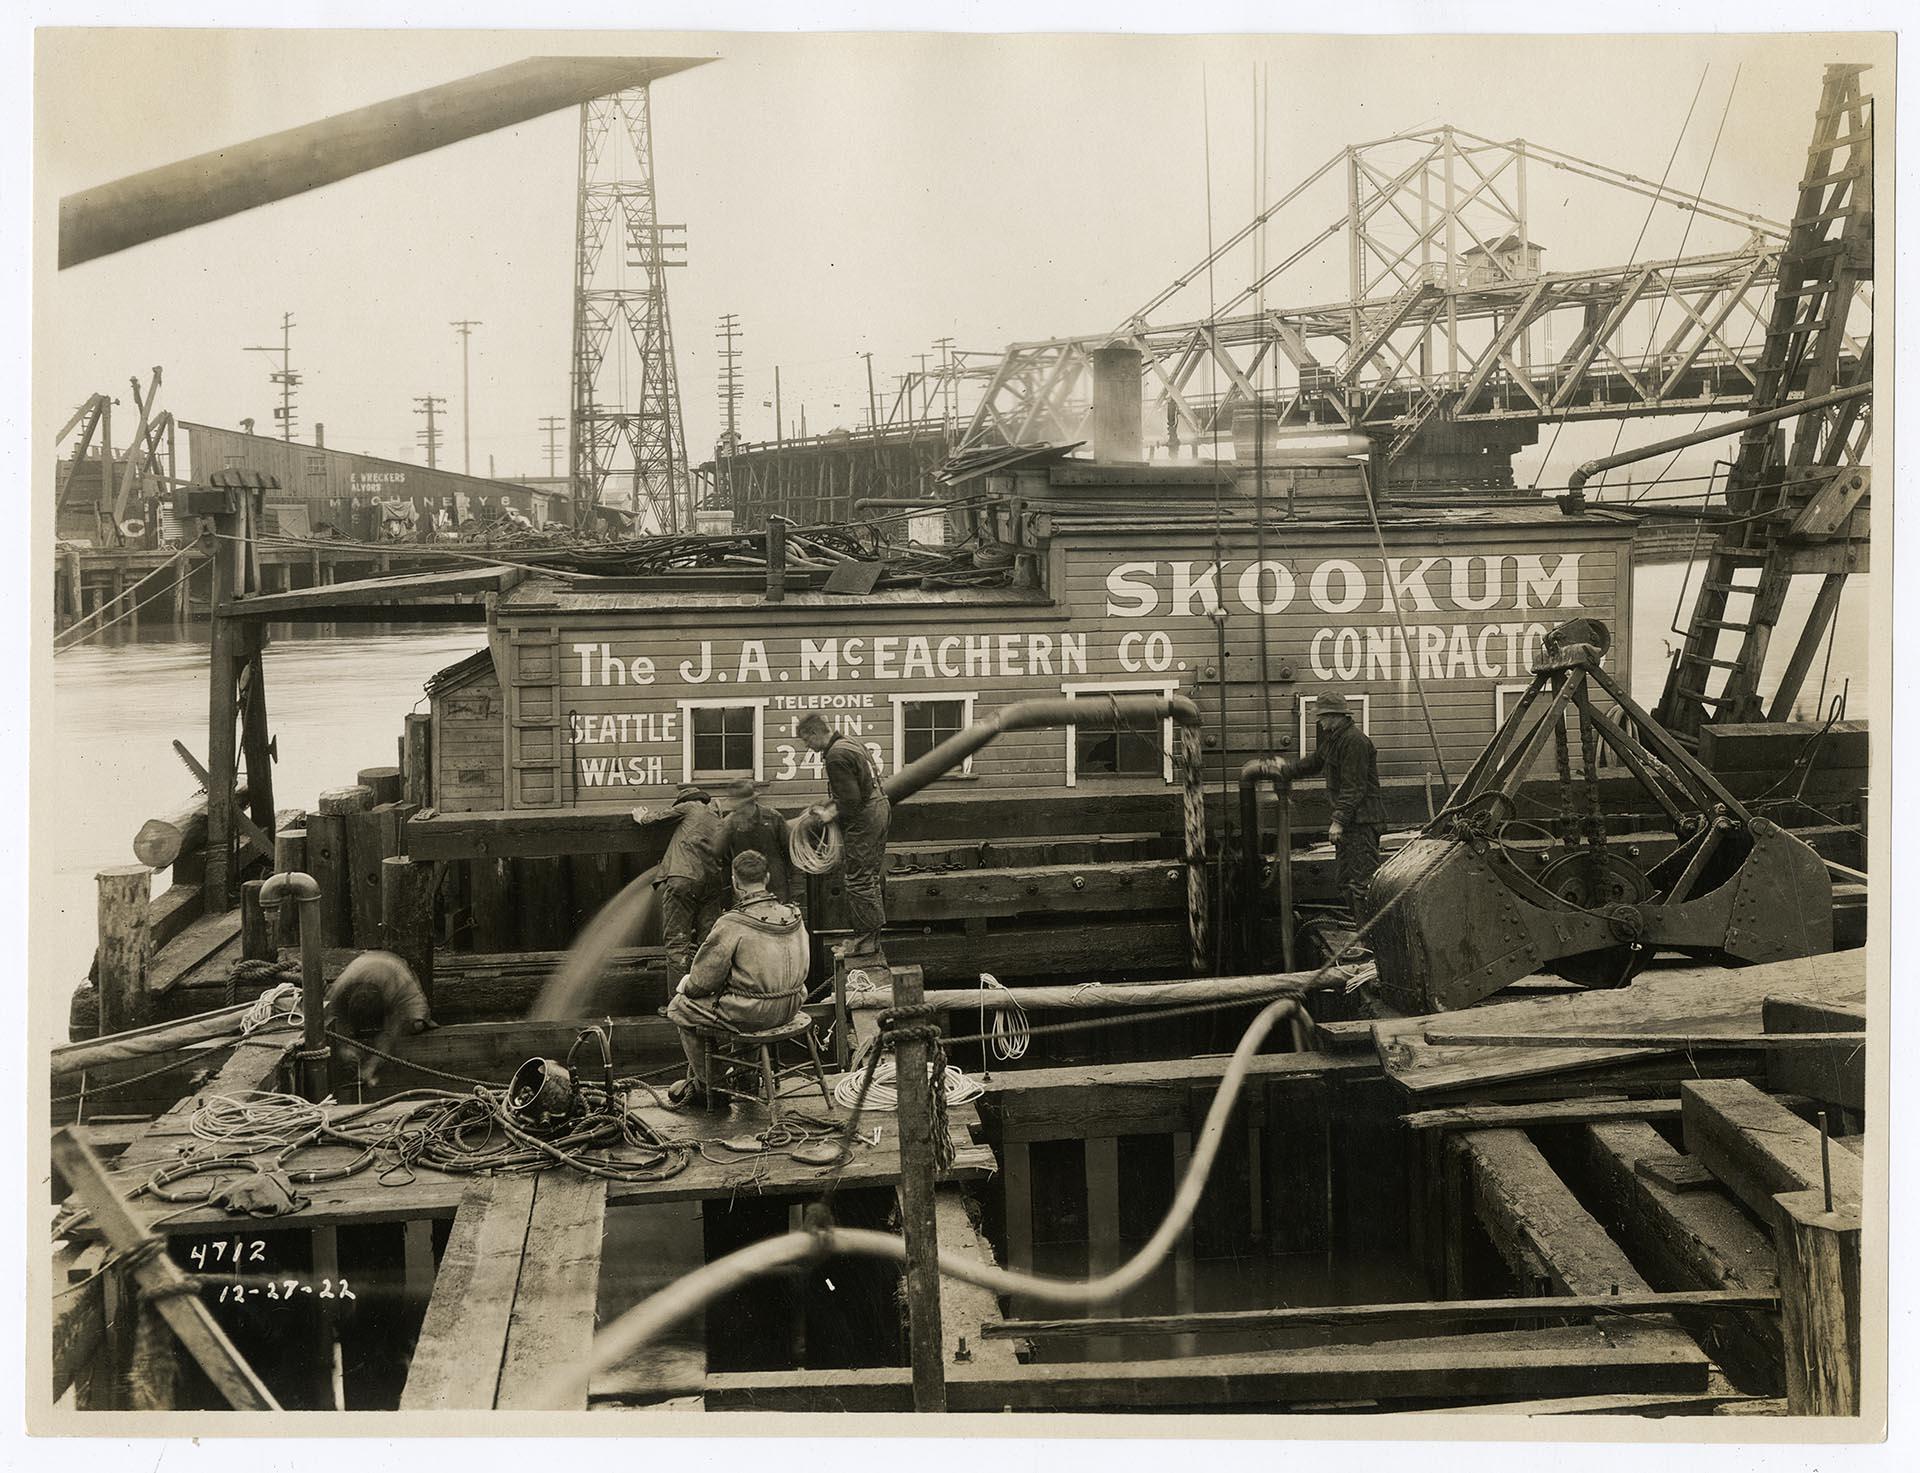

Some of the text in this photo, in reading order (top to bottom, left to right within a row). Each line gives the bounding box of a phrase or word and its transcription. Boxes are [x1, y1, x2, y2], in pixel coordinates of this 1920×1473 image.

[360, 472, 406, 483] WRECKERS
[1106, 553, 1587, 618] SKOOKUM
[573, 643, 655, 686] The
[1118, 631, 1187, 672] CO.
[775, 694, 874, 709] TELEPONE
[568, 713, 677, 743] SEATTLE
[581, 756, 668, 786] WASH.
